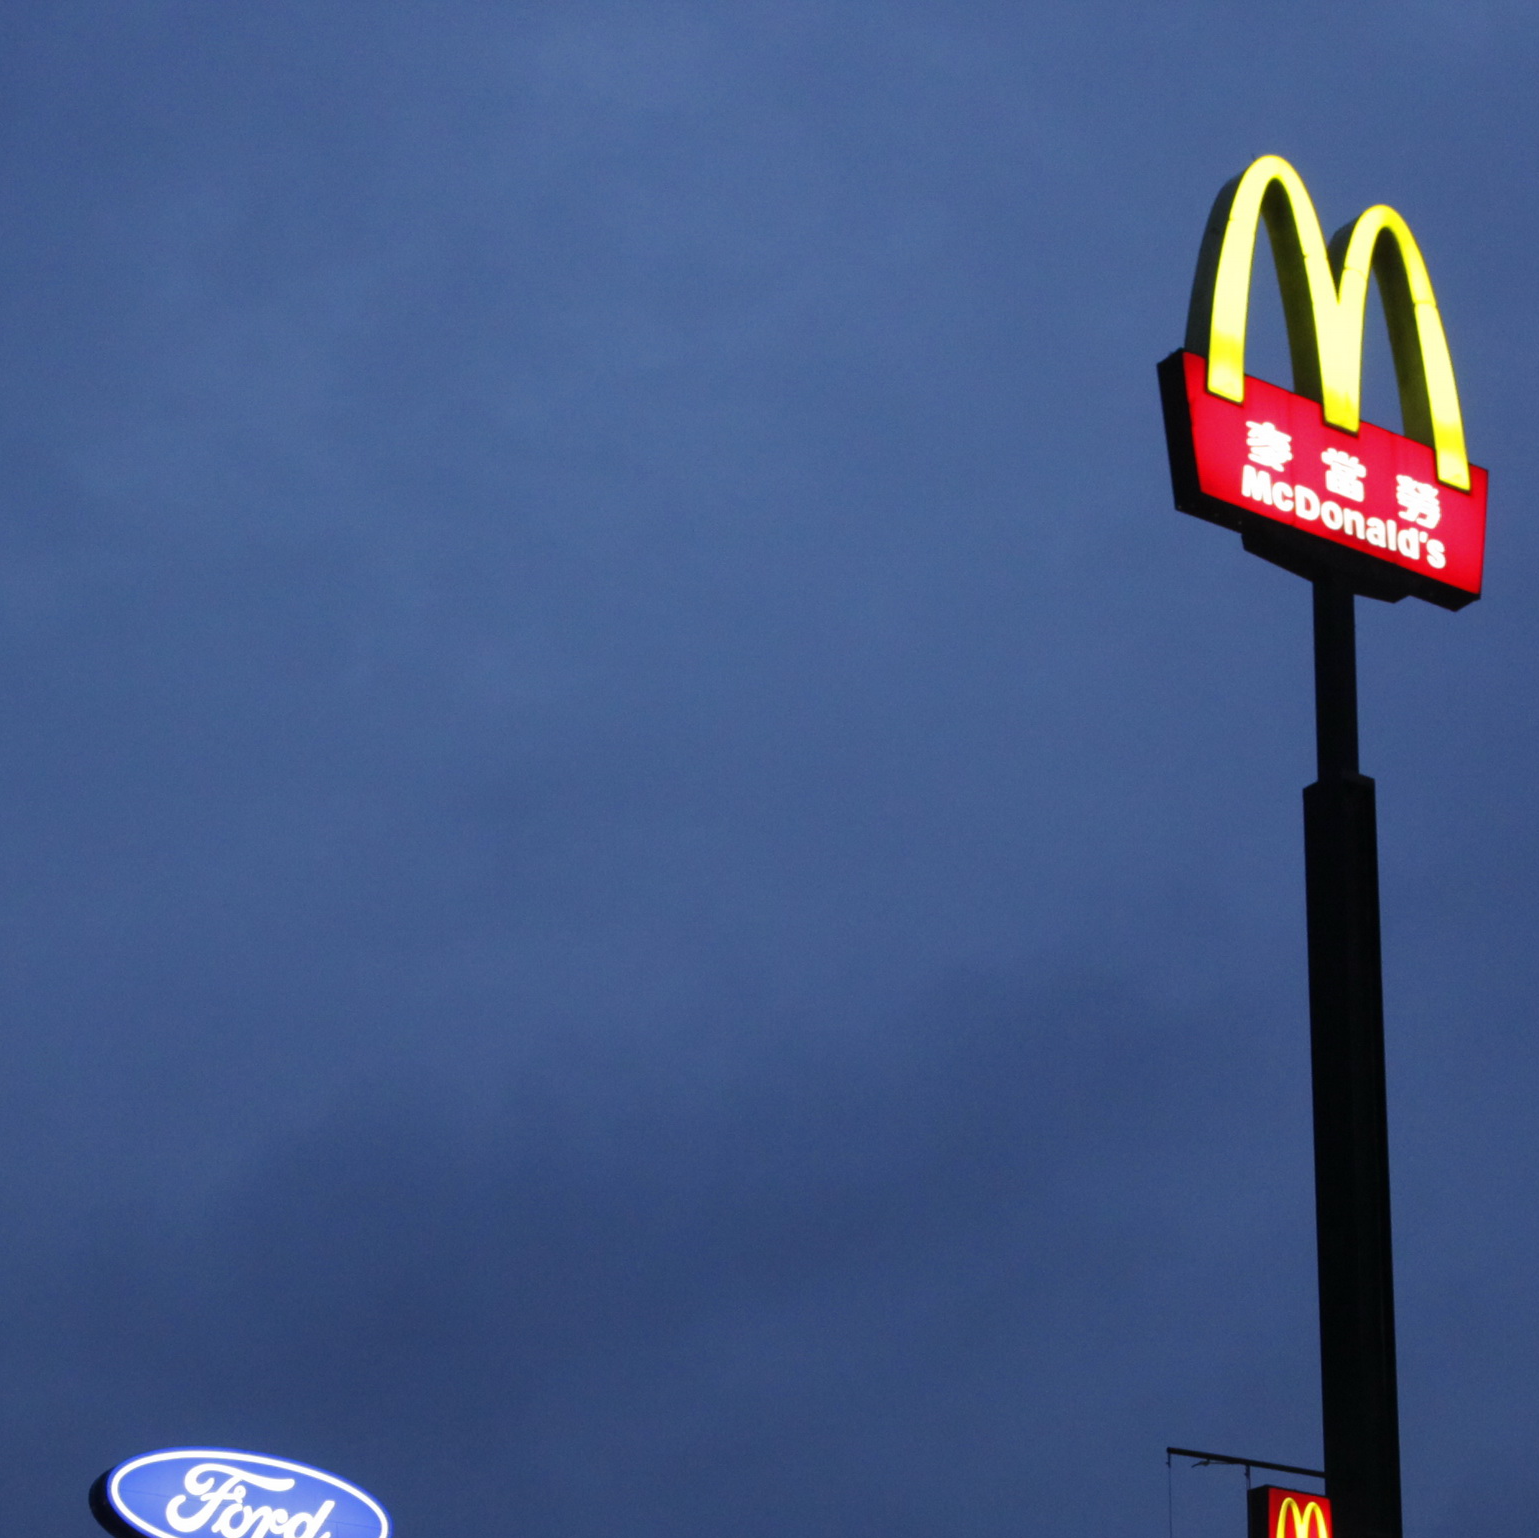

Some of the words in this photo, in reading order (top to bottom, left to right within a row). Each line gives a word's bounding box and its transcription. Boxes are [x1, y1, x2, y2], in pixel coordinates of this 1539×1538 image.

[1241, 465, 1447, 569] McDonald's
[1245, 421, 1441, 529] 麥當勞
